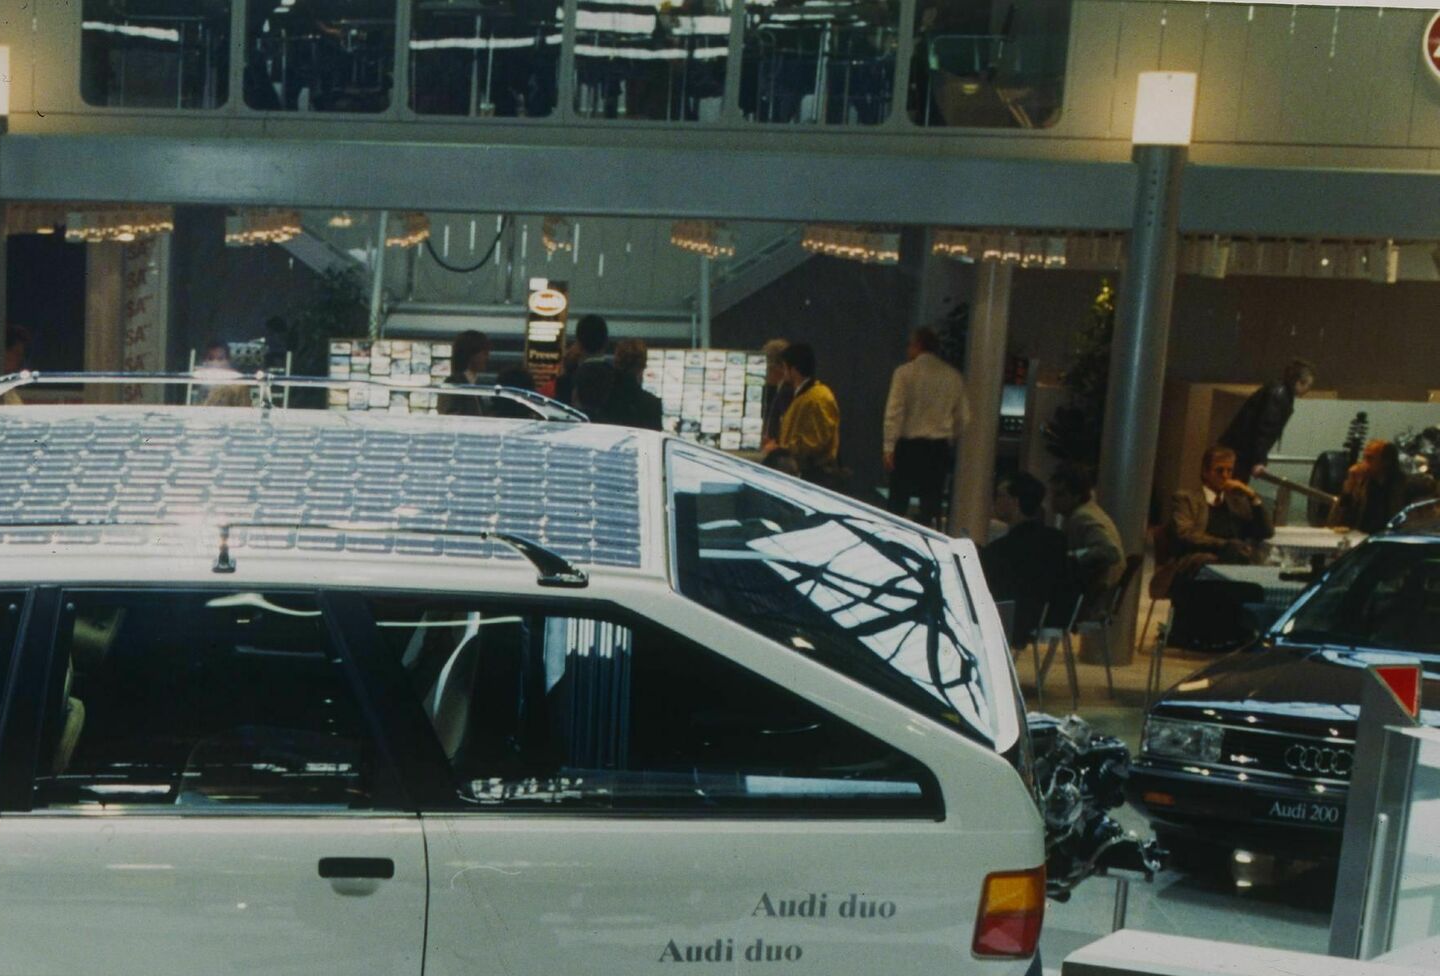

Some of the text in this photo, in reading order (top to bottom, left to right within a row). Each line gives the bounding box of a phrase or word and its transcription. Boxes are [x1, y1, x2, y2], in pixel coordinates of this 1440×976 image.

[1268, 801, 1340, 823] Audi 200
[751, 892, 897, 918] Audi duo
[658, 938, 803, 963] Audi duo
